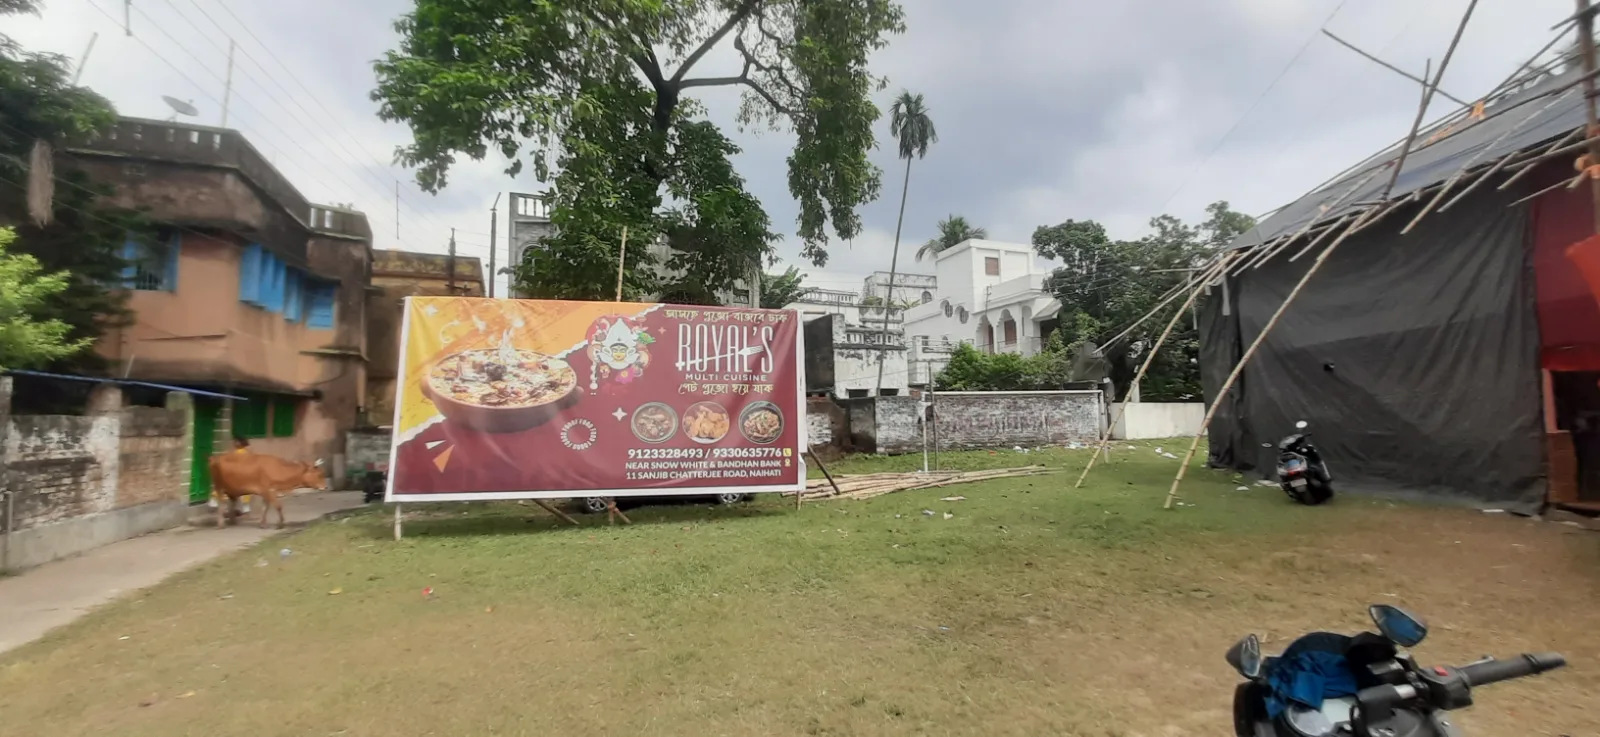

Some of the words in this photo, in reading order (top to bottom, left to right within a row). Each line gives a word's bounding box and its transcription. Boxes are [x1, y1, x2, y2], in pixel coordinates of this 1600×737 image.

[703, 311, 730, 322] পুজো
[733, 312, 765, 324] বাজবে
[768, 313, 788, 323] ঢাক
[677, 323, 773, 373] ROYAL'S
[685, 373, 719, 381] MULTI
[723, 374, 768, 382] CUISINE
[678, 381, 699, 394] পেট
[702, 383, 729, 395] পুজো
[753, 383, 774, 394] যাক
[628, 448, 704, 459] 9123328493
[714, 447, 782, 458] 9330635776
[625, 461, 649, 470] NEAR
[651, 461, 679, 469] SNOW
[680, 460, 708, 469] WHITE
[710, 460, 716, 468] &
[717, 460, 759, 468] BANDHAN
[760, 459, 782, 467] BANK
[626, 472, 636, 480] 11
[638, 471, 668, 480] SANJIB
[669, 470, 721, 479] CHATTERJEE
[723, 470, 749, 478] ROAD,
[750, 469, 781, 477] NAIHATI
